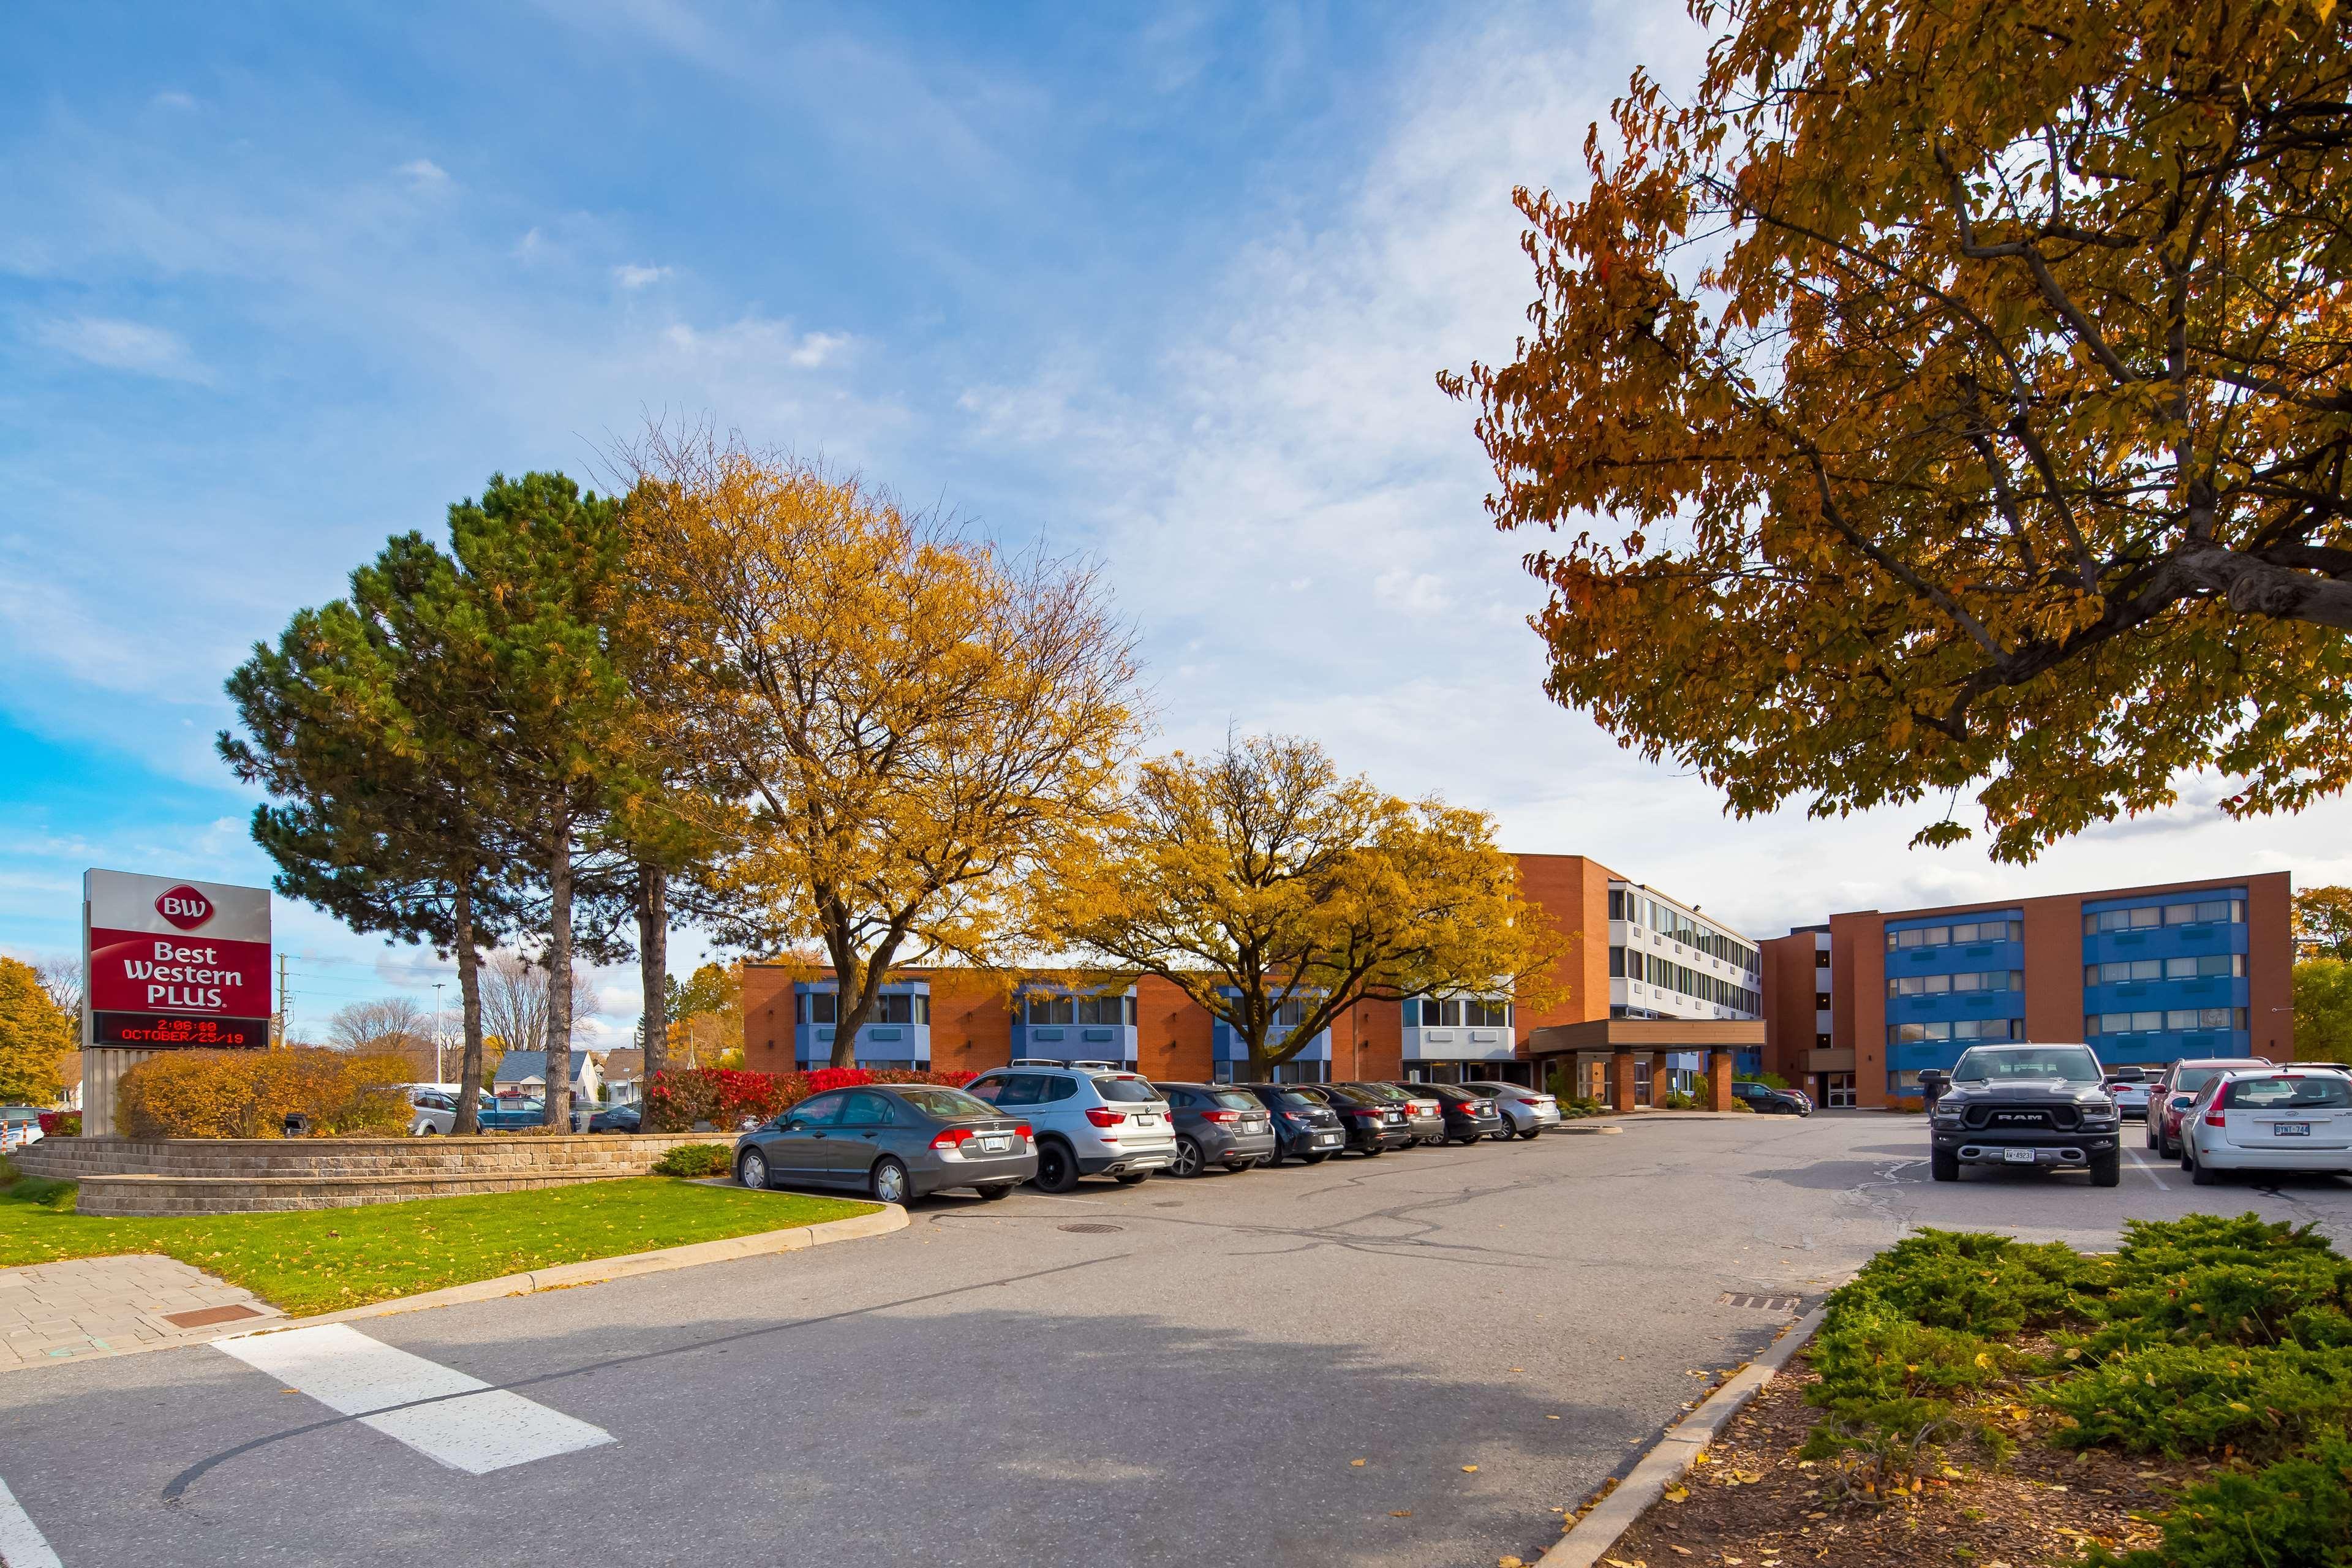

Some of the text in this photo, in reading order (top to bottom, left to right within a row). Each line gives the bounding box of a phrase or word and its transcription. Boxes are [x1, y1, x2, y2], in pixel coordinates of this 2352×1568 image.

[164, 897, 206, 918] BW
[154, 941, 217, 965] Best
[124, 959, 243, 986] Western
[148, 984, 222, 1008] PLUS
[122, 1029, 244, 1044] OCTOBER/25/19
